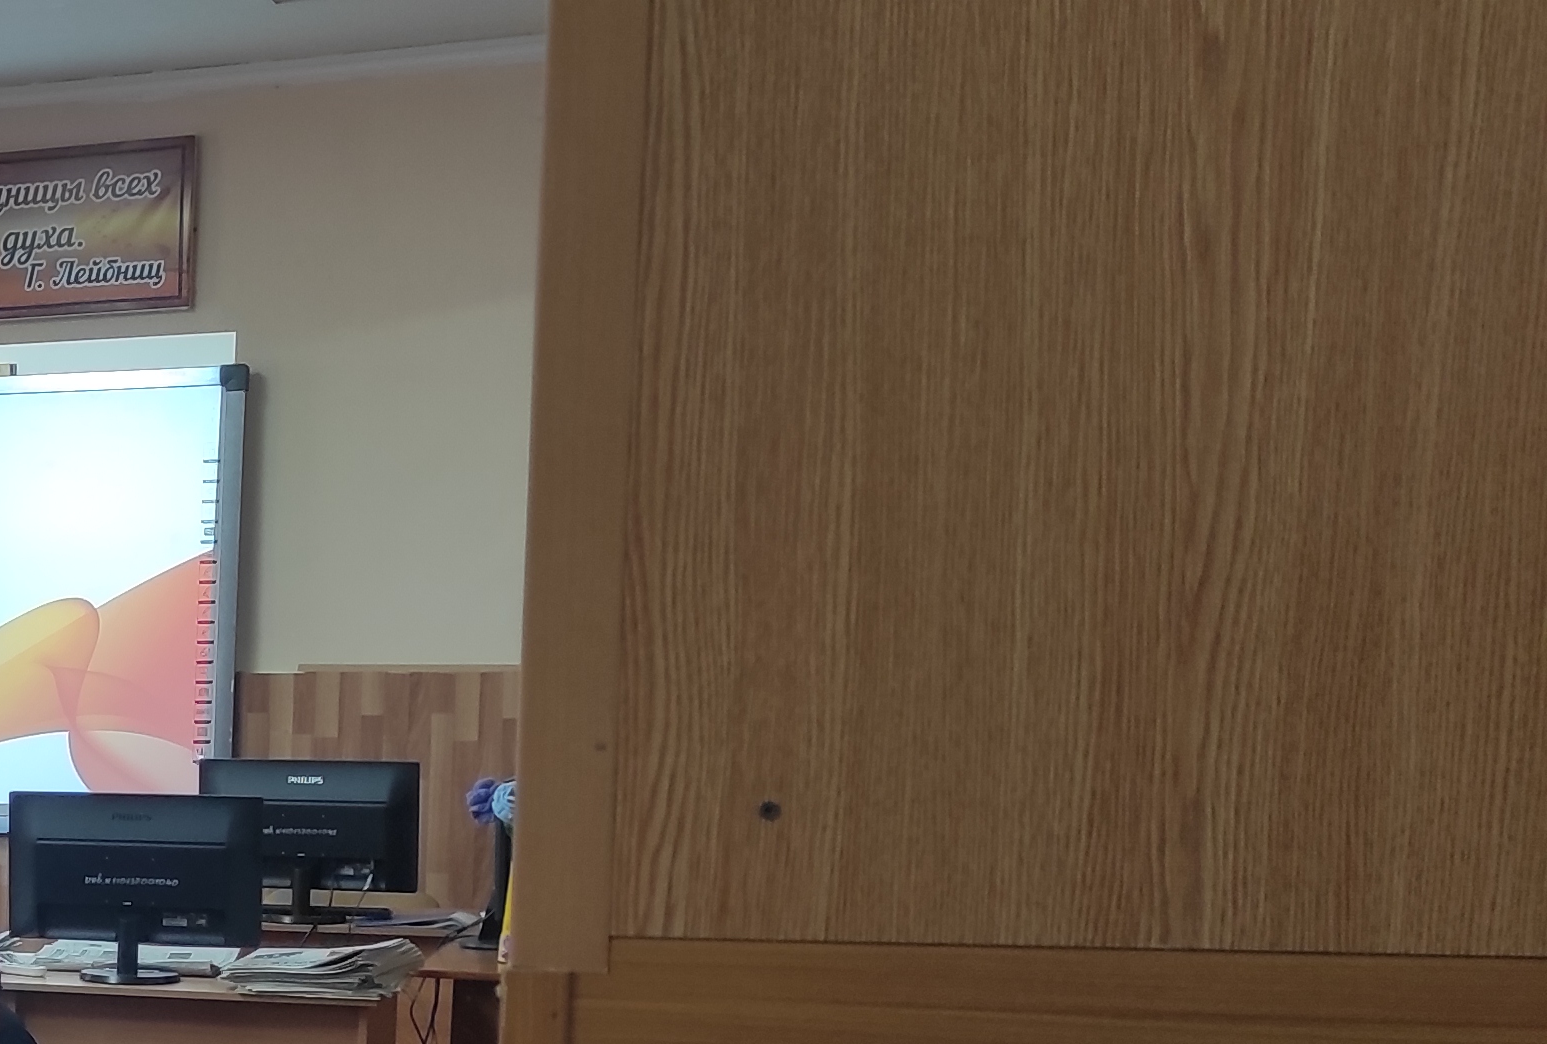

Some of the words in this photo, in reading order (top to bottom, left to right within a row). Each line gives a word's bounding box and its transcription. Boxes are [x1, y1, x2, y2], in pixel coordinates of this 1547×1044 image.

[92, 169, 161, 200] всех
[0, 225, 84, 267] духа.
[24, 261, 45, 291] Г.
[51, 259, 165, 289] Лейбниц
[287, 776, 324, 785] PHILIPS
